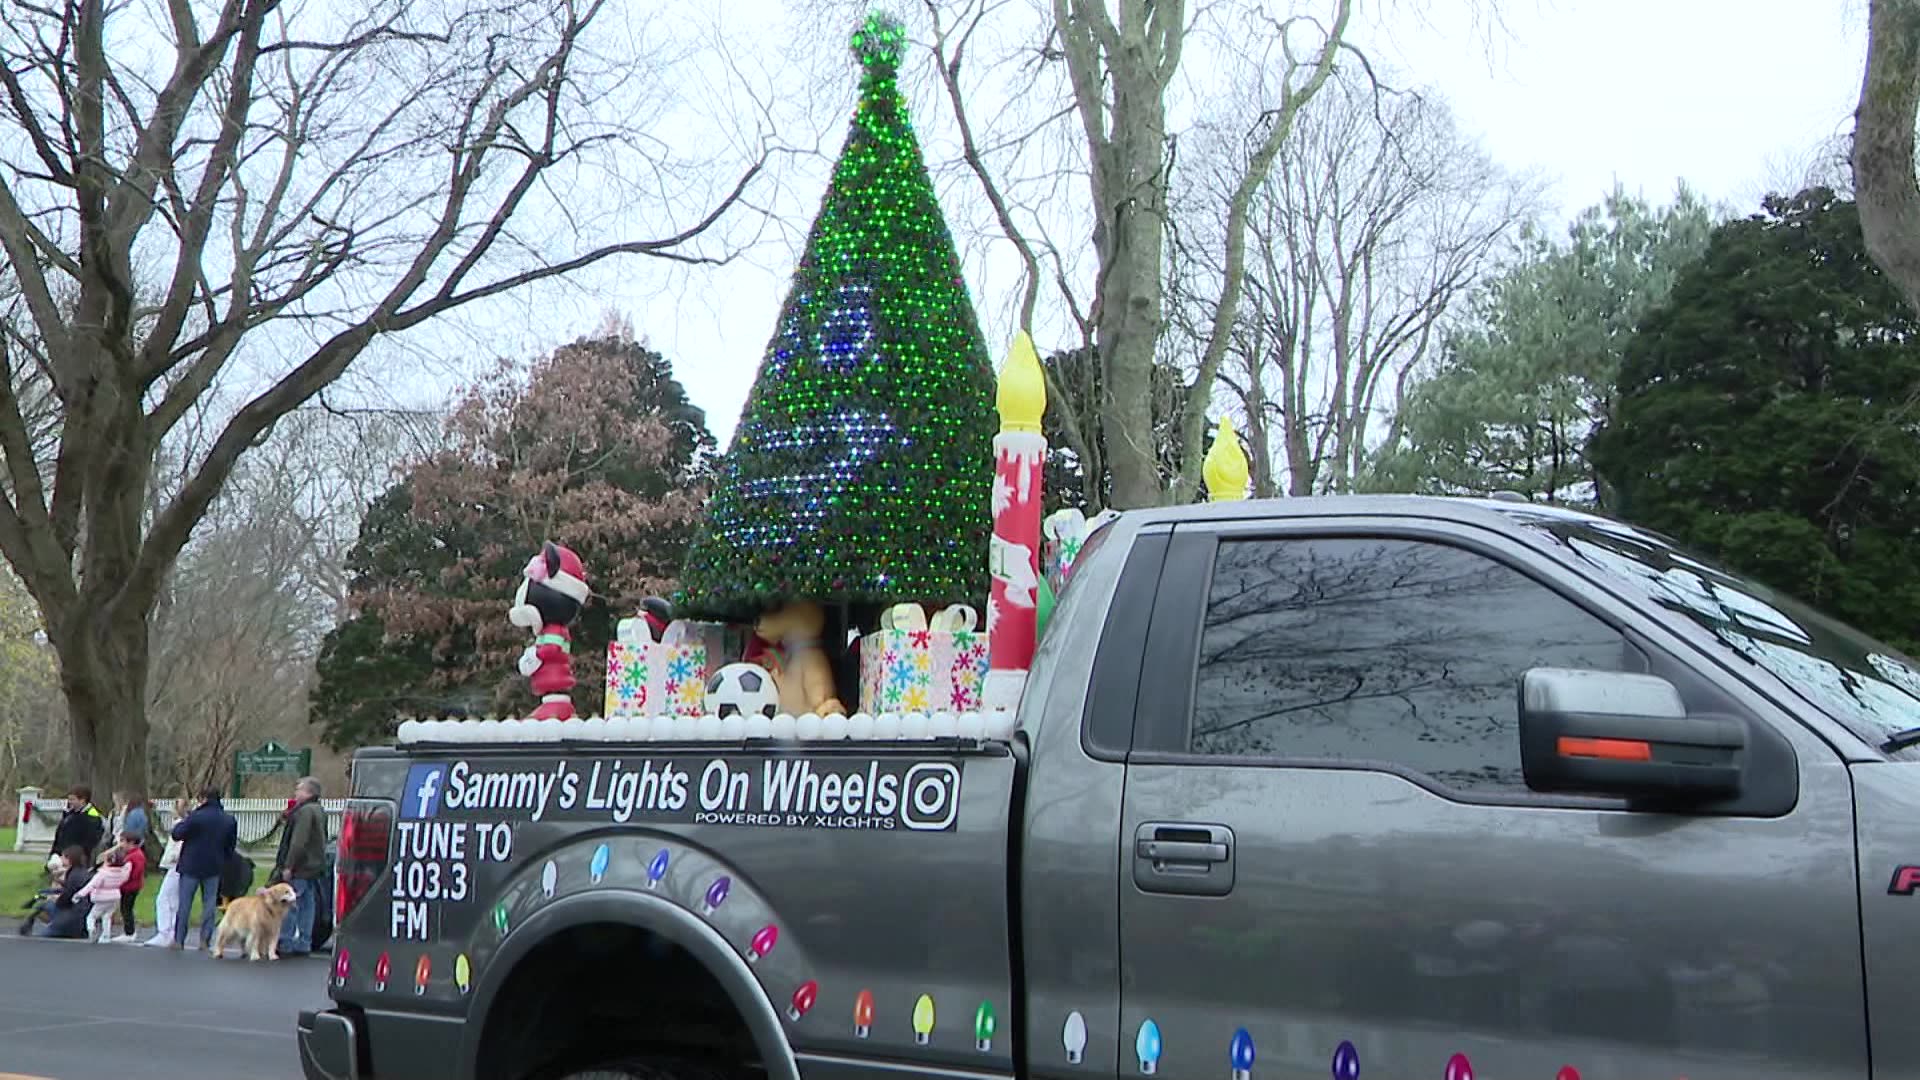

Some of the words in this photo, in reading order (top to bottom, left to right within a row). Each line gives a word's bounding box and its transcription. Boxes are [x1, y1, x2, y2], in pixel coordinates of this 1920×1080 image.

[446, 761, 579, 822] Sammy's
[586, 760, 689, 822] Lights
[699, 759, 750, 811] On
[763, 760, 898, 816] Wheels
[695, 812, 781, 825] POWERED
[786, 814, 808, 827] BY
[815, 816, 895, 829] XLIGHTS
[397, 823, 466, 859] TUNE
[475, 822, 512, 861] TO
[392, 862, 467, 901] 103.3
[391, 901, 427, 940] FM
